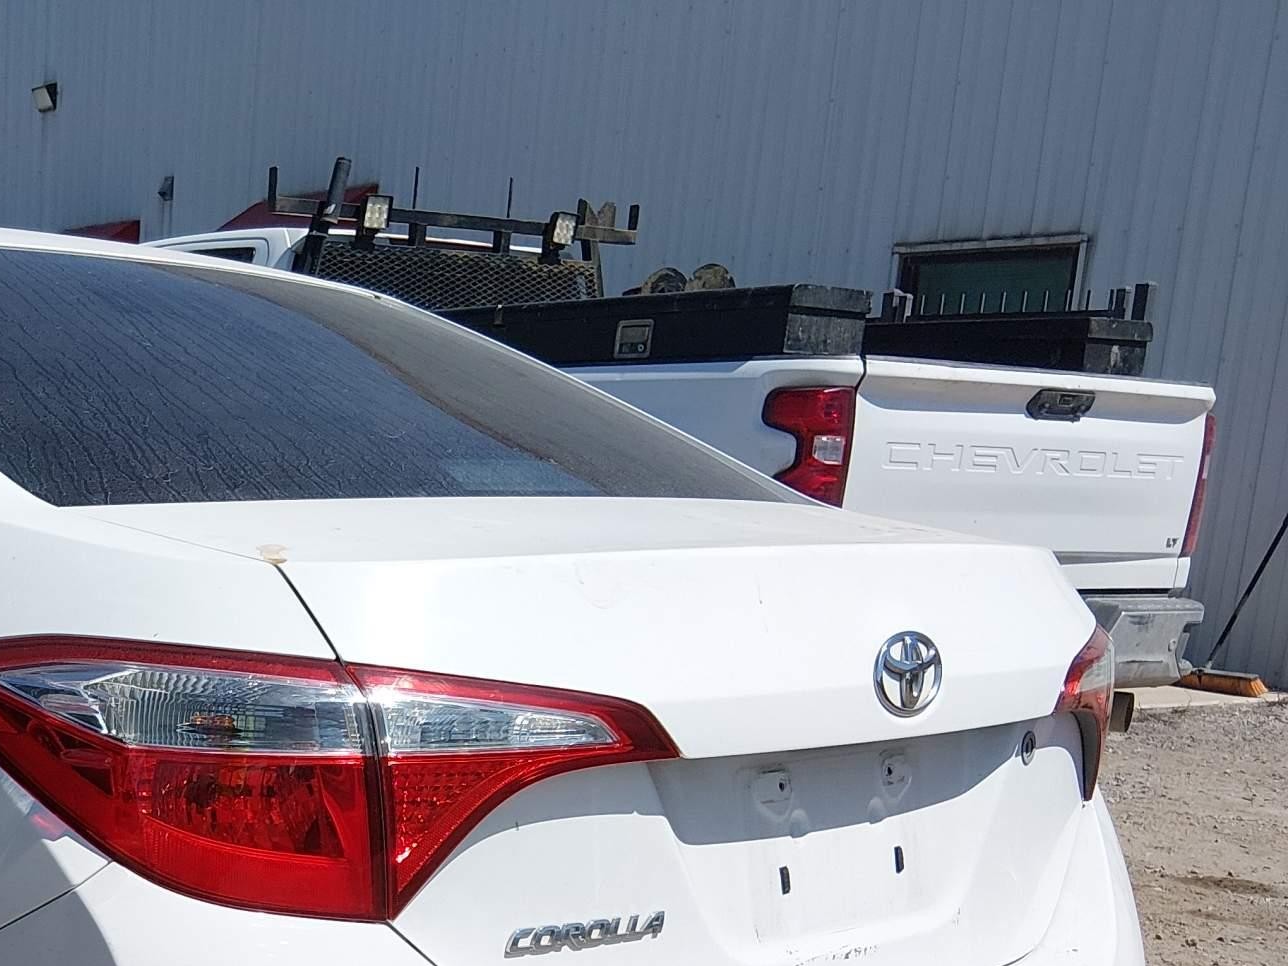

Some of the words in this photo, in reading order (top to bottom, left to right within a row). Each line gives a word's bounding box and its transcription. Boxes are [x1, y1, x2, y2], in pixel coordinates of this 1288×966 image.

[881, 441, 1184, 481] CHEVROLET
[1165, 537, 1179, 548] LT
[504, 910, 665, 958] COROLLA
